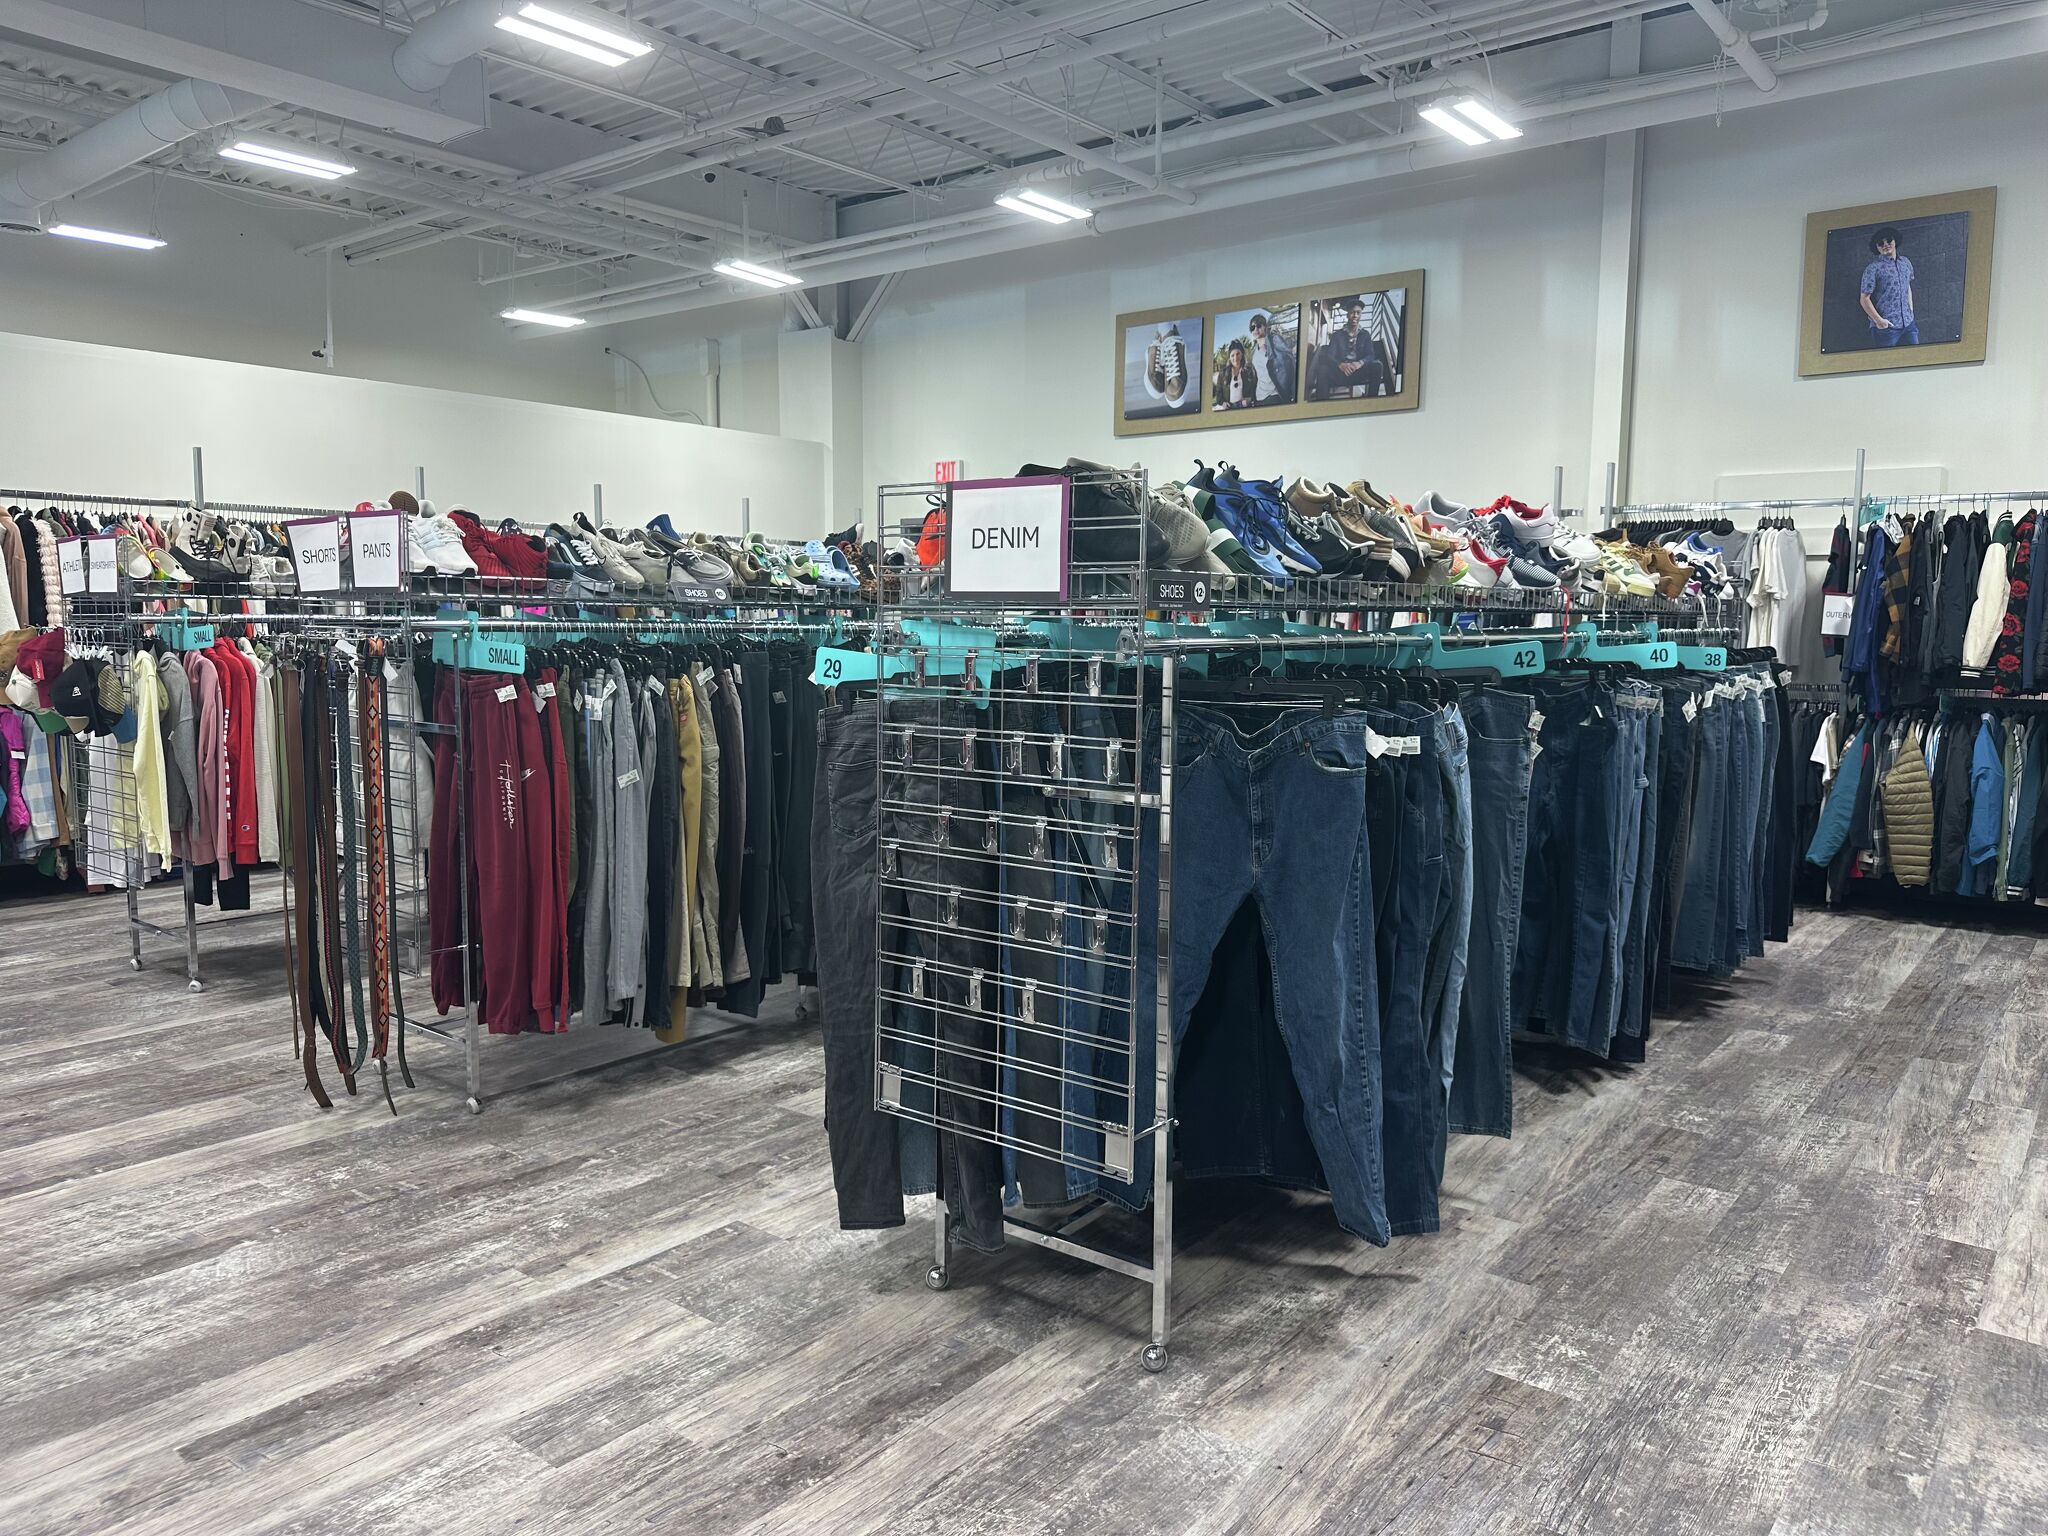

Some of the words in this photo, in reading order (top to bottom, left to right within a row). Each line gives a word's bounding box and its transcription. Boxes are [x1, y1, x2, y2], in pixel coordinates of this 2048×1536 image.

[935, 461, 956, 482] EXIT
[972, 526, 1040, 550] DENIM
[302, 547, 337, 565] SHORTS
[363, 542, 391, 559] PANTS
[684, 588, 708, 598] SHOES
[1160, 584, 1185, 599] SHOES
[193, 629, 212, 644] SMALL
[488, 647, 520, 667] SMALL
[1513, 649, 1537, 669] 42
[1649, 648, 1669, 663] 40
[1704, 653, 1721, 667] 38
[823, 658, 842, 680] 29
[497, 760, 516, 829] Hollister
